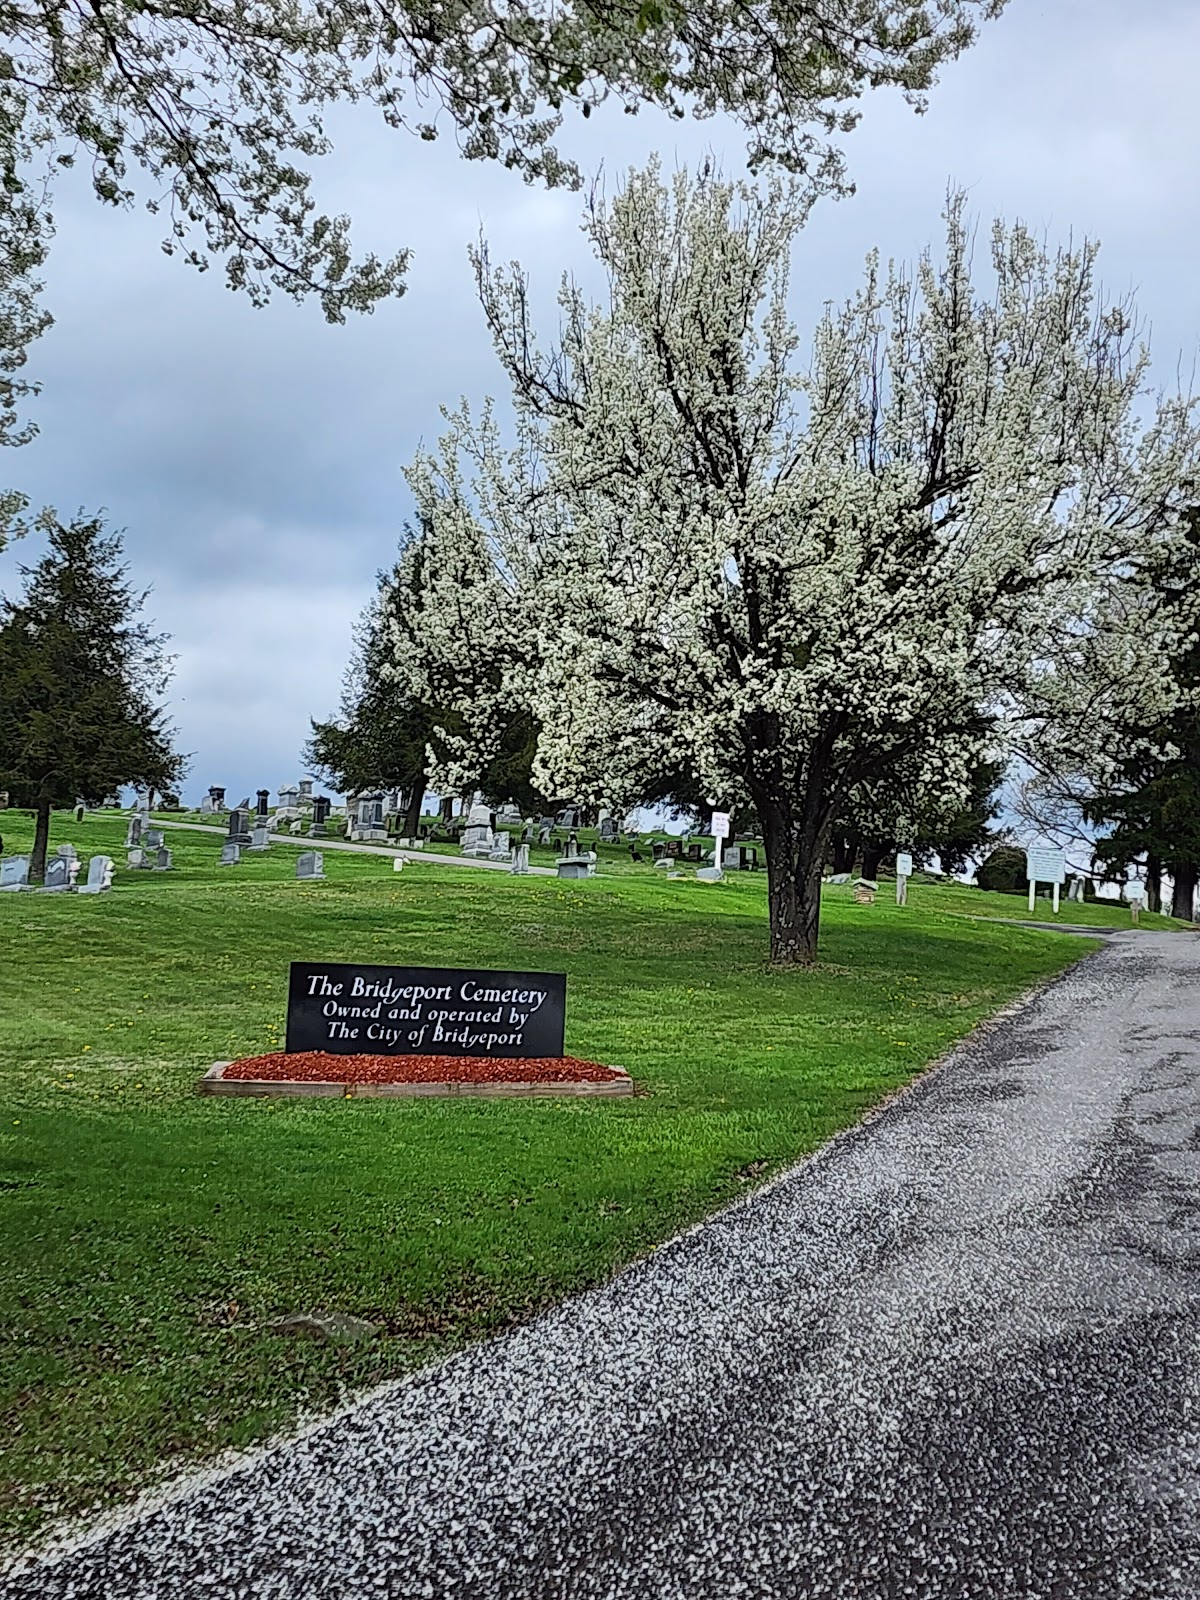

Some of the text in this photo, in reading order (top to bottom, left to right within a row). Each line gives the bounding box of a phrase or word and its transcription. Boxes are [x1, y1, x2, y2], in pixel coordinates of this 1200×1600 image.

[307, 975, 547, 1012] The Bridgeport Cemetery
[323, 1000, 529, 1030] Owned and operated by
[327, 1021, 523, 1050] The City of Bridgeport
